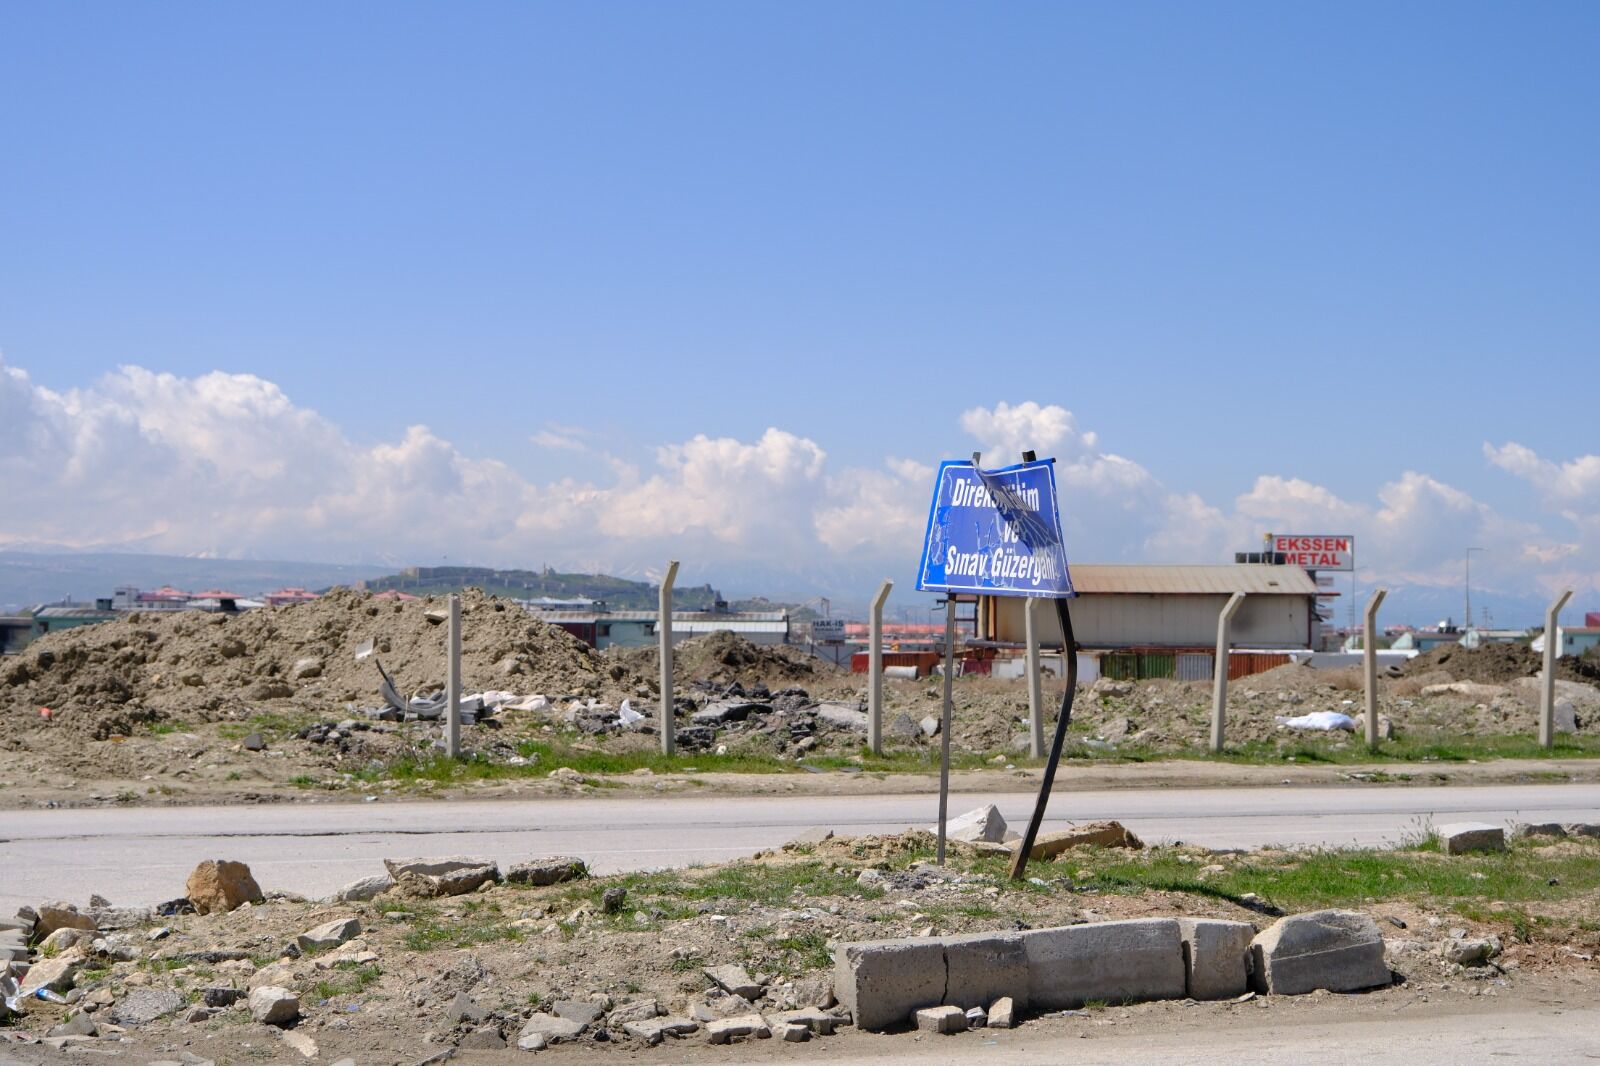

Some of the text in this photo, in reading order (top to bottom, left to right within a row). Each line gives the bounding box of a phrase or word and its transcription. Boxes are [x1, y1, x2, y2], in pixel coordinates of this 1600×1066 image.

[1004, 520, 1020, 543] ve
[1276, 538, 1347, 551] EKSSEN
[945, 546, 988, 576] Sınav
[1284, 553, 1341, 566] METAL
